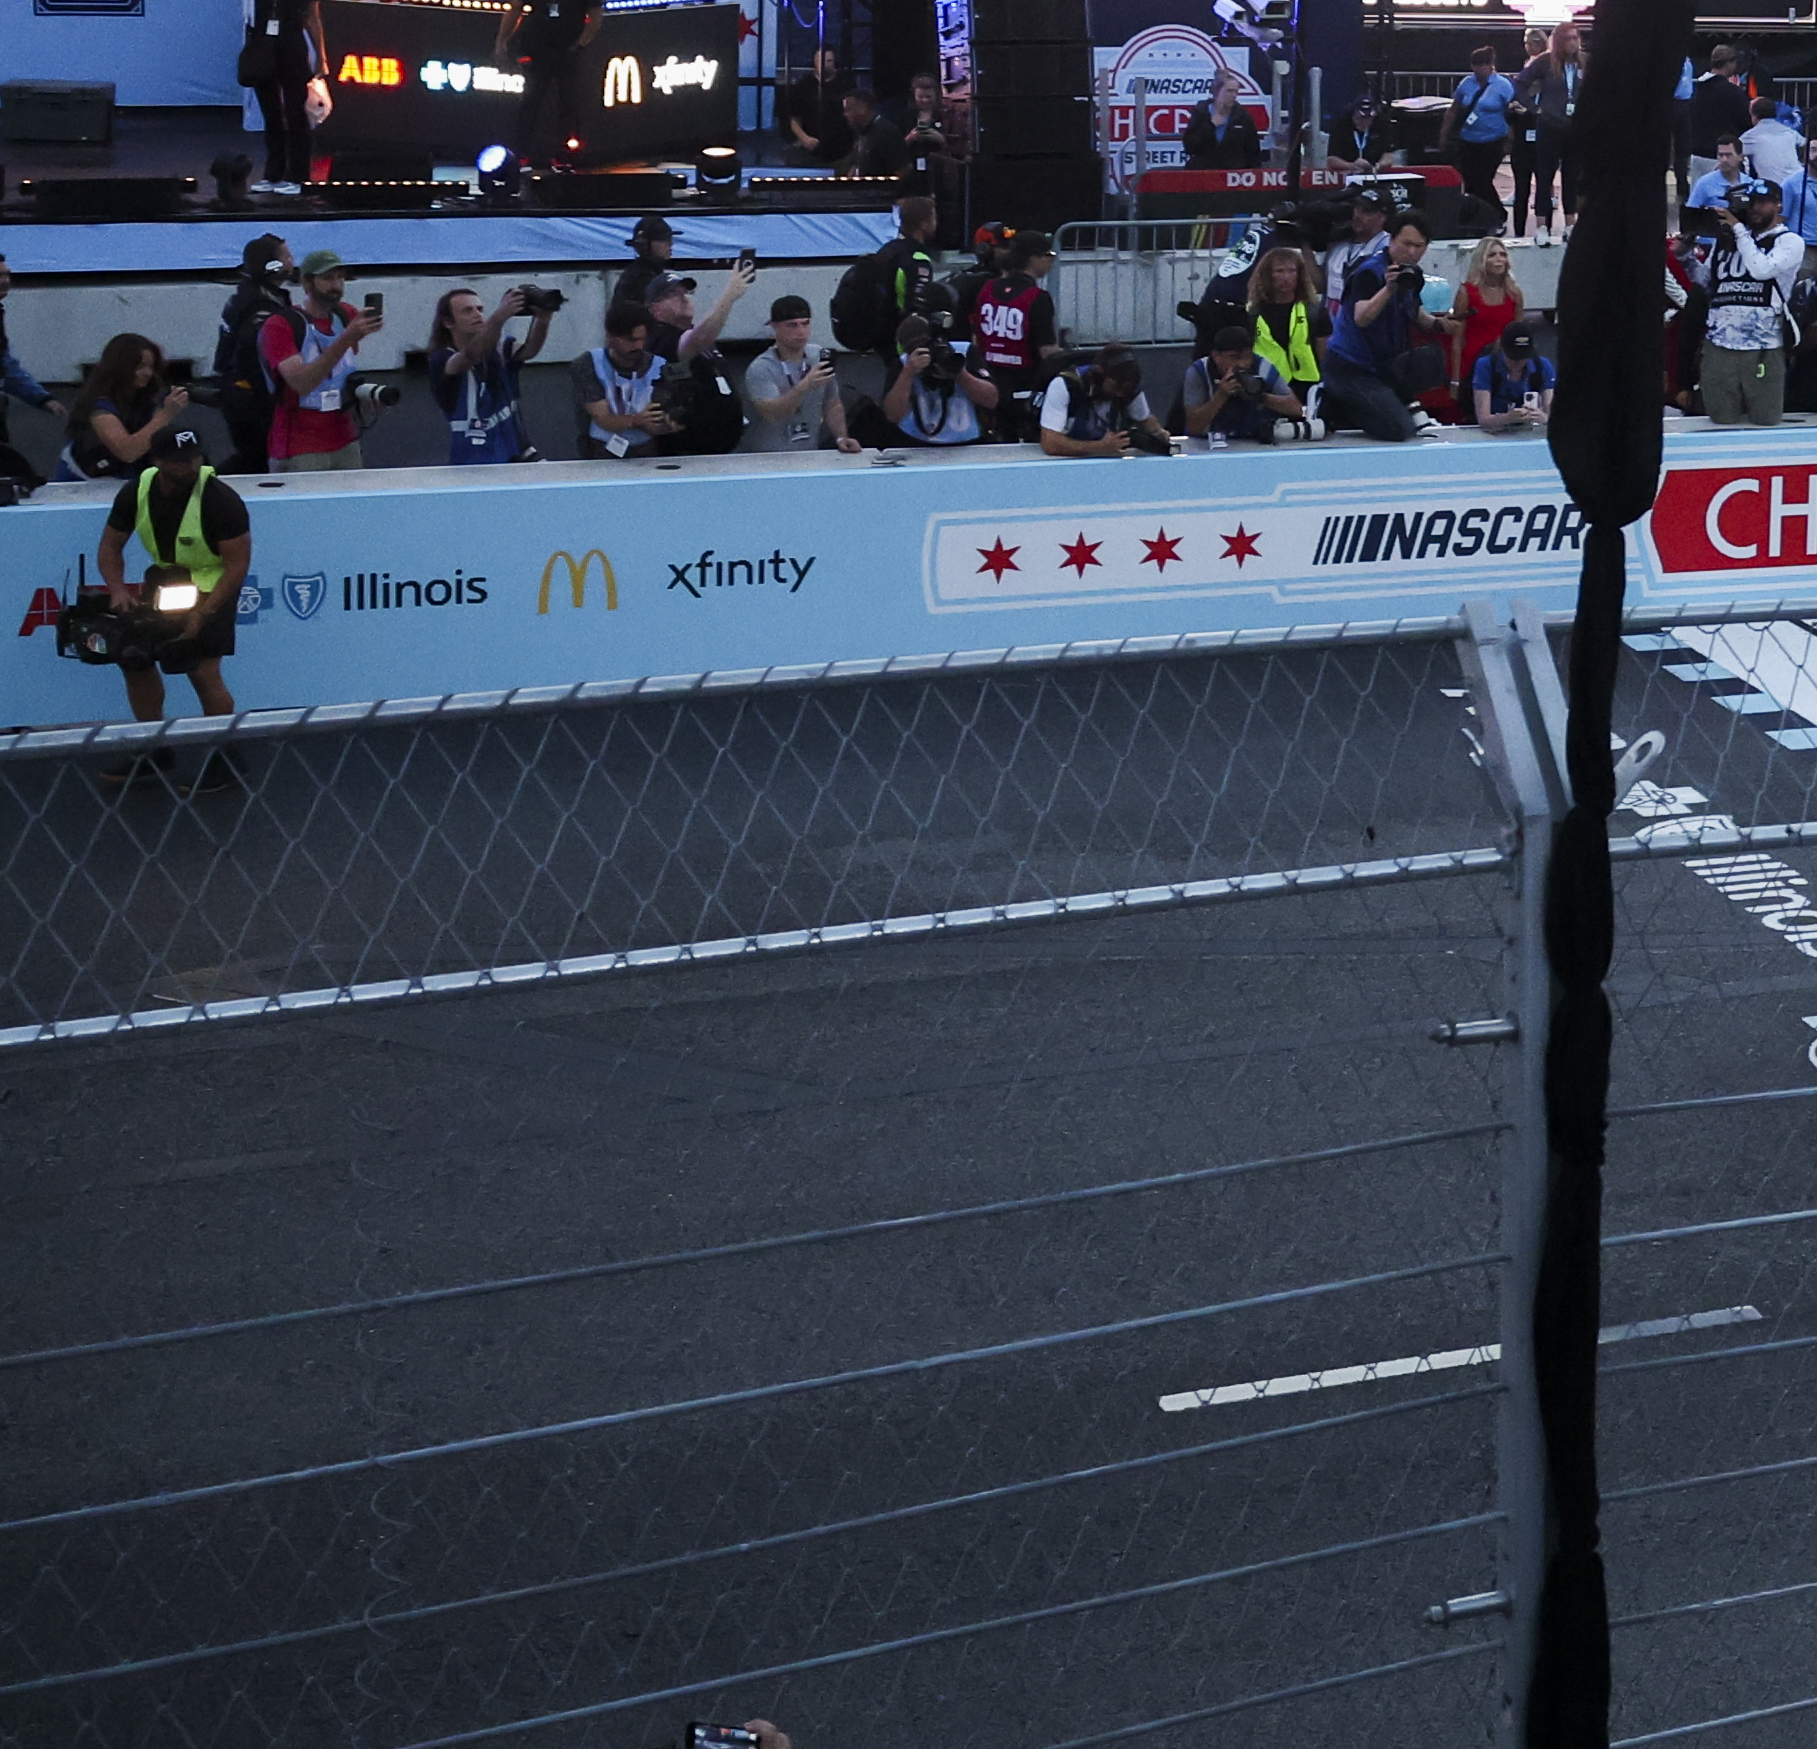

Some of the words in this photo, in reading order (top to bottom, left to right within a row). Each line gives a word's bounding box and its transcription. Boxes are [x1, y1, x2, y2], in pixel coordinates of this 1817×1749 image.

[338, 54, 402, 86] ABB
[1123, 151, 1179, 164] SREET
[1226, 171, 1256, 187] DO
[1262, 171, 1305, 187] NO
[980, 303, 1025, 341] 349
[1382, 505, 1588, 561] NASCAR
[343, 567, 488, 611] Illinois
[666, 547, 817, 599] xfinity
